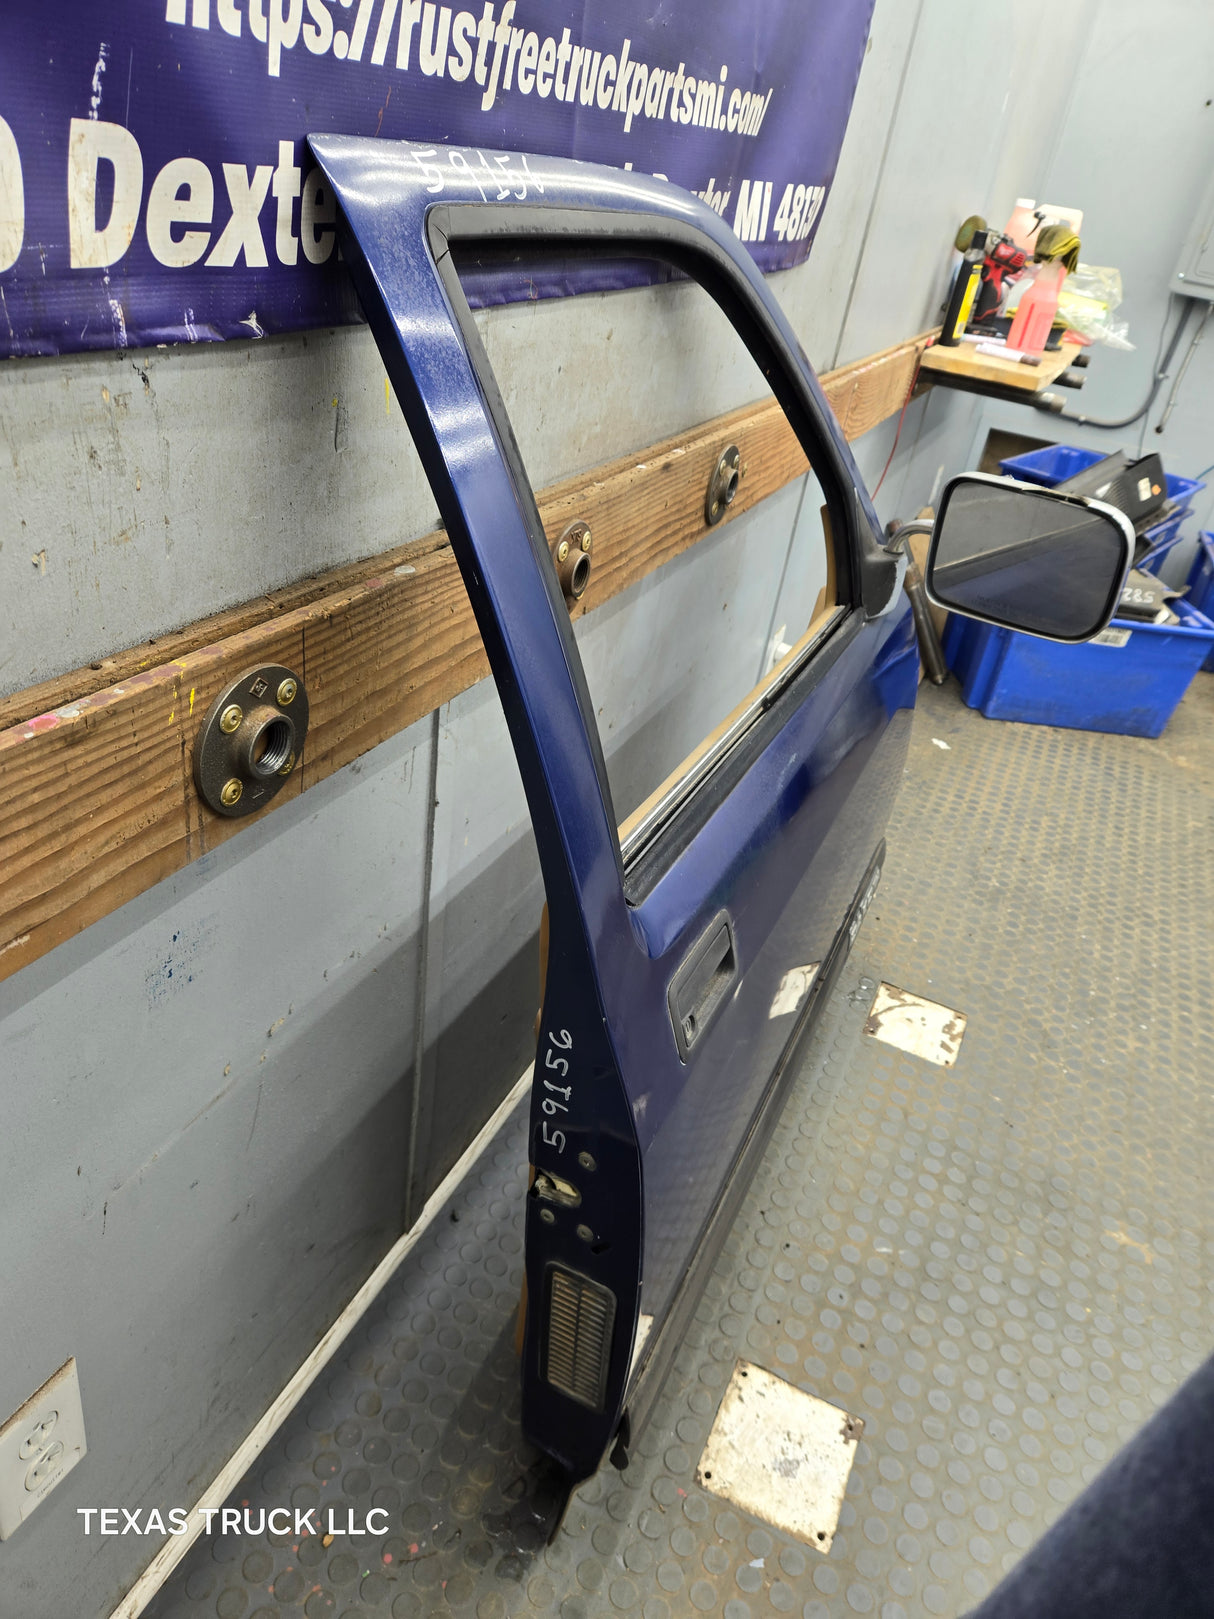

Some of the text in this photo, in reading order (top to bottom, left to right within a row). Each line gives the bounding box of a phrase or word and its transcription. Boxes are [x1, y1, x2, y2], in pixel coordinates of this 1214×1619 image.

[68, 117, 343, 269] Dexte
[733, 179, 773, 241] MI
[541, 1029, 573, 1154] 59156
